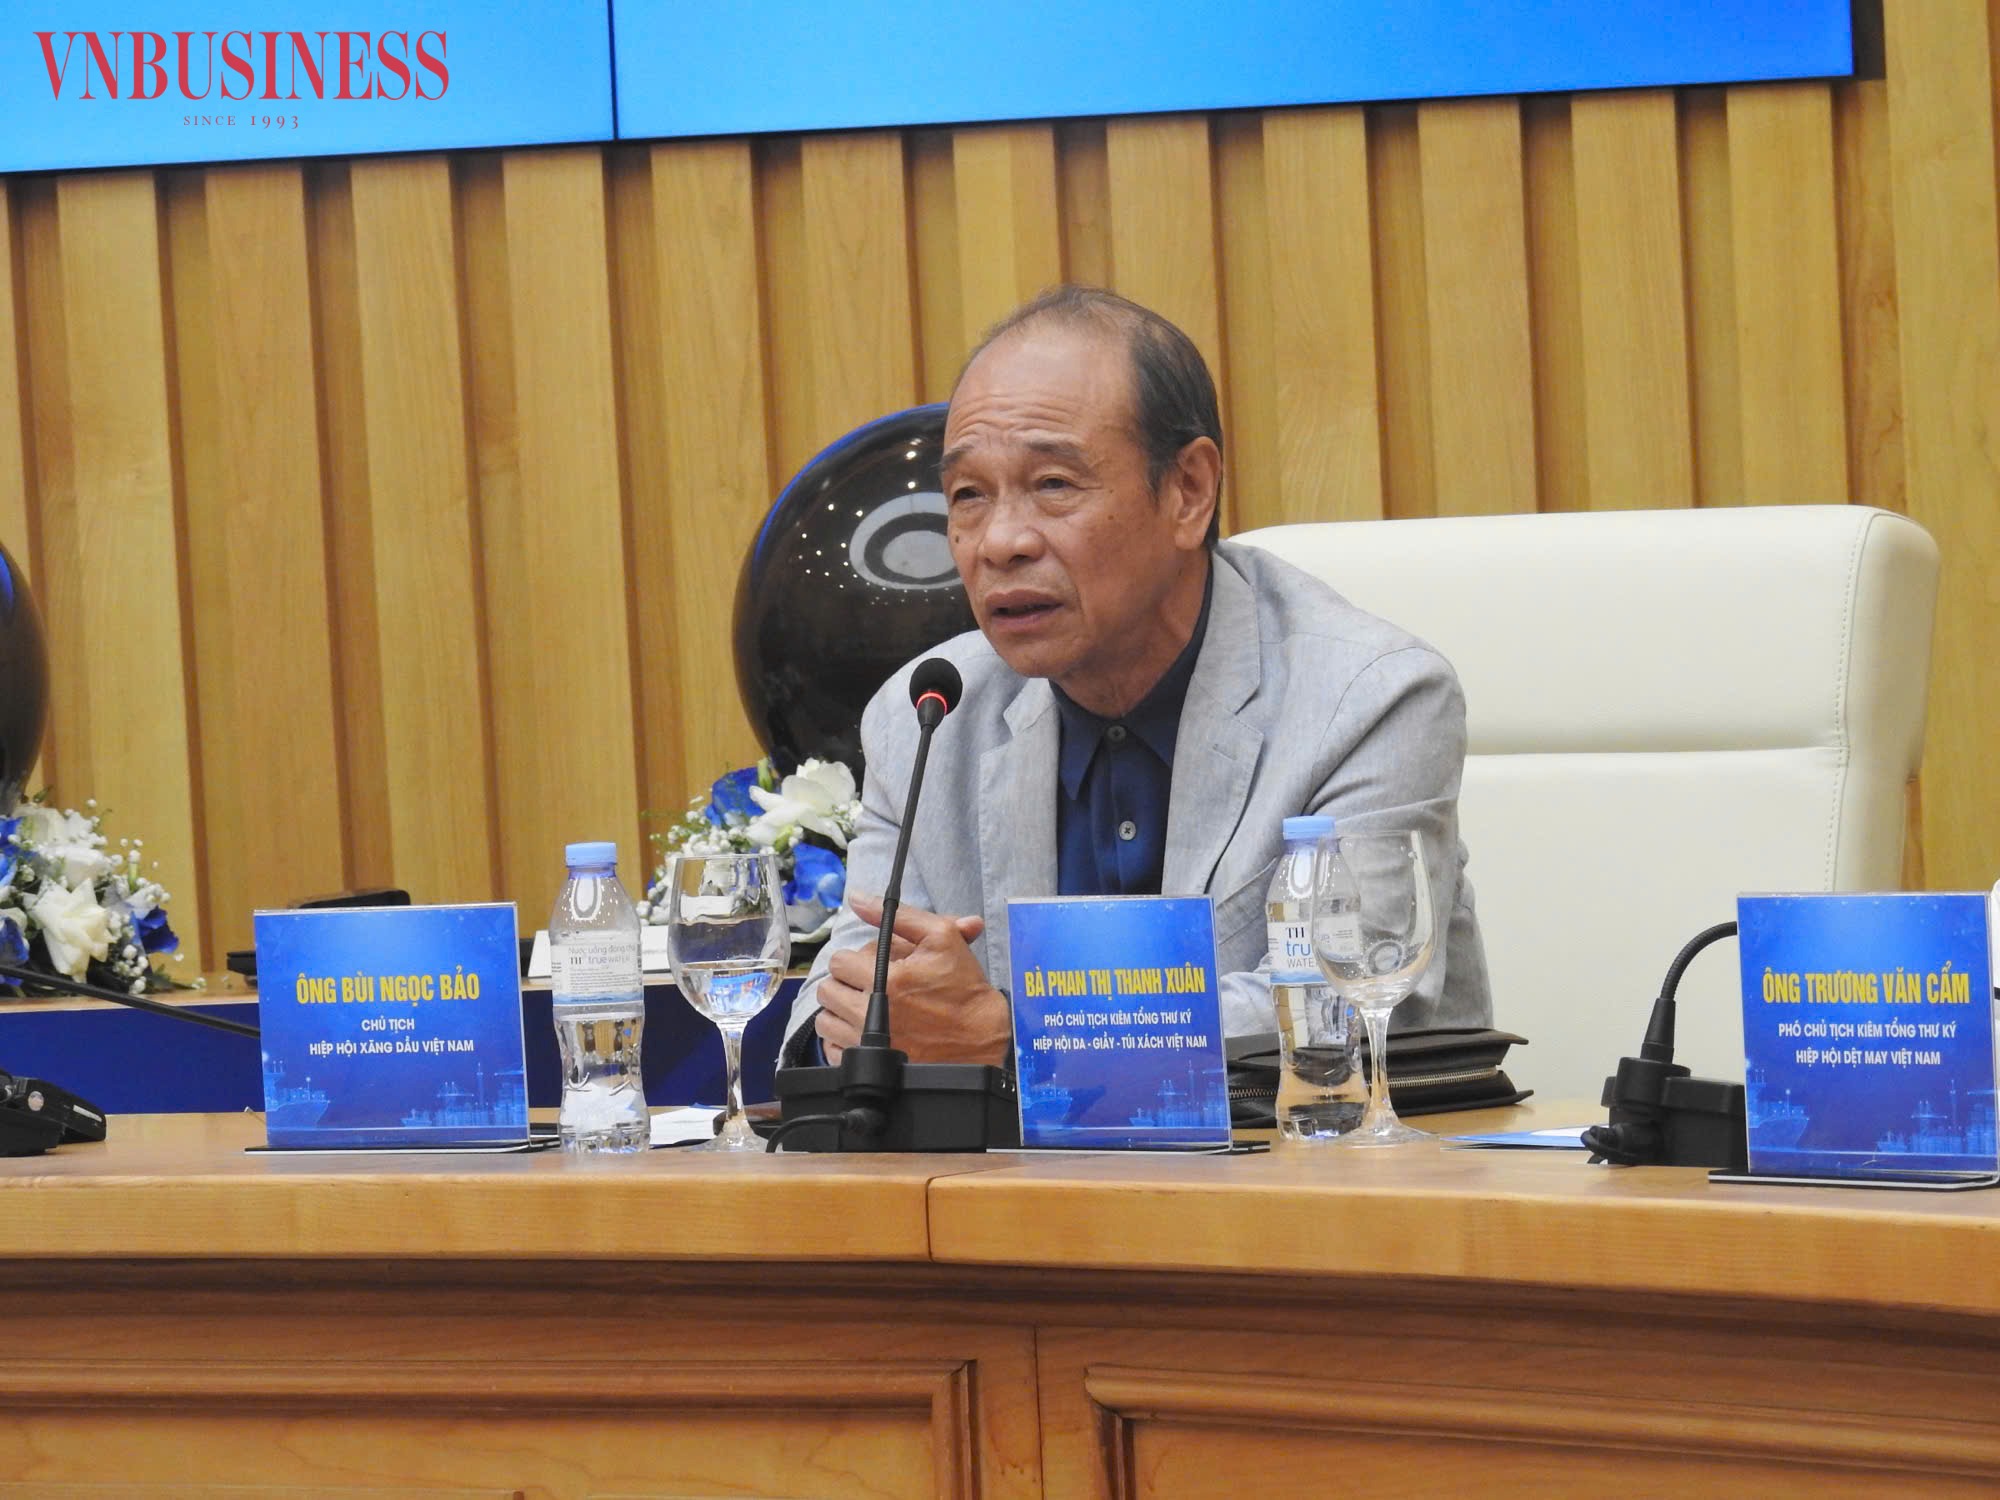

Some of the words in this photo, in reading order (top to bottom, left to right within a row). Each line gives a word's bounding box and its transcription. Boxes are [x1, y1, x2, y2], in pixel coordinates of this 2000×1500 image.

[1286, 941, 1311, 957] tru
[296, 972, 337, 1004] ÔNG
[342, 971, 375, 1003] BÙI
[380, 974, 435, 1007] NGỌC
[440, 965, 481, 1000] BẢO
[1024, 965, 1046, 998] BÀ
[1048, 971, 1088, 997] PHAN
[1089, 969, 1113, 1001] THỊ
[1114, 968, 1163, 995] THANH
[1165, 961, 1206, 994] XUÂN
[1762, 966, 1801, 1004] ÔNG
[1805, 971, 1878, 1004] TRƯƠNG
[1882, 967, 1922, 1004] VĂN
[1926, 960, 1971, 1004] CẨM
[361, 1015, 386, 1031] CHỦ
[389, 1018, 415, 1033] TỊCH
[1044, 1010, 1064, 1027] PHÓ
[1065, 1010, 1086, 1026] CHỦ
[1087, 1013, 1108, 1029] TỊCH
[1110, 1009, 1132, 1026] KIÊM
[1132, 1006, 1159, 1025] TỔNG
[1160, 1011, 1179, 1024] THƯ
[1180, 1008, 1192, 1025] KÝ
[1778, 1019, 1801, 1038] PHÓ
[1803, 1018, 1827, 1038] CHỦ
[1829, 1023, 1854, 1041] TỊCH
[1857, 1020, 1883, 1038] KIÊM
[1885, 1016, 1916, 1038] TỔNG
[1918, 1022, 1940, 1038] THƯ
[1942, 1020, 1957, 1038] KÝ
[309, 1040, 333, 1058] HIỆP
[336, 1039, 357, 1058] HỘI
[360, 1039, 393, 1054] XĂNG
[422, 1037, 445, 1056] VIỆT
[448, 1040, 474, 1052] NAM
[1033, 1035, 1052, 1054] HIỆP
[1054, 1034, 1072, 1053] HỘI
[1073, 1037, 1086, 1050] DA
[1121, 1032, 1136, 1049] TÚI
[1137, 1031, 1165, 1049] XÁCH
[1166, 1032, 1184, 1052] VIỆT
[1186, 1035, 1207, 1047] NAM
[1796, 1046, 1819, 1067] HIỆP
[1821, 1046, 1841, 1068] HỘI
[1844, 1047, 1862, 1068] DỆT
[1864, 1051, 1888, 1064] MAY
[1890, 1047, 1912, 1069] VIỆT
[1915, 1051, 1941, 1065] NAM
